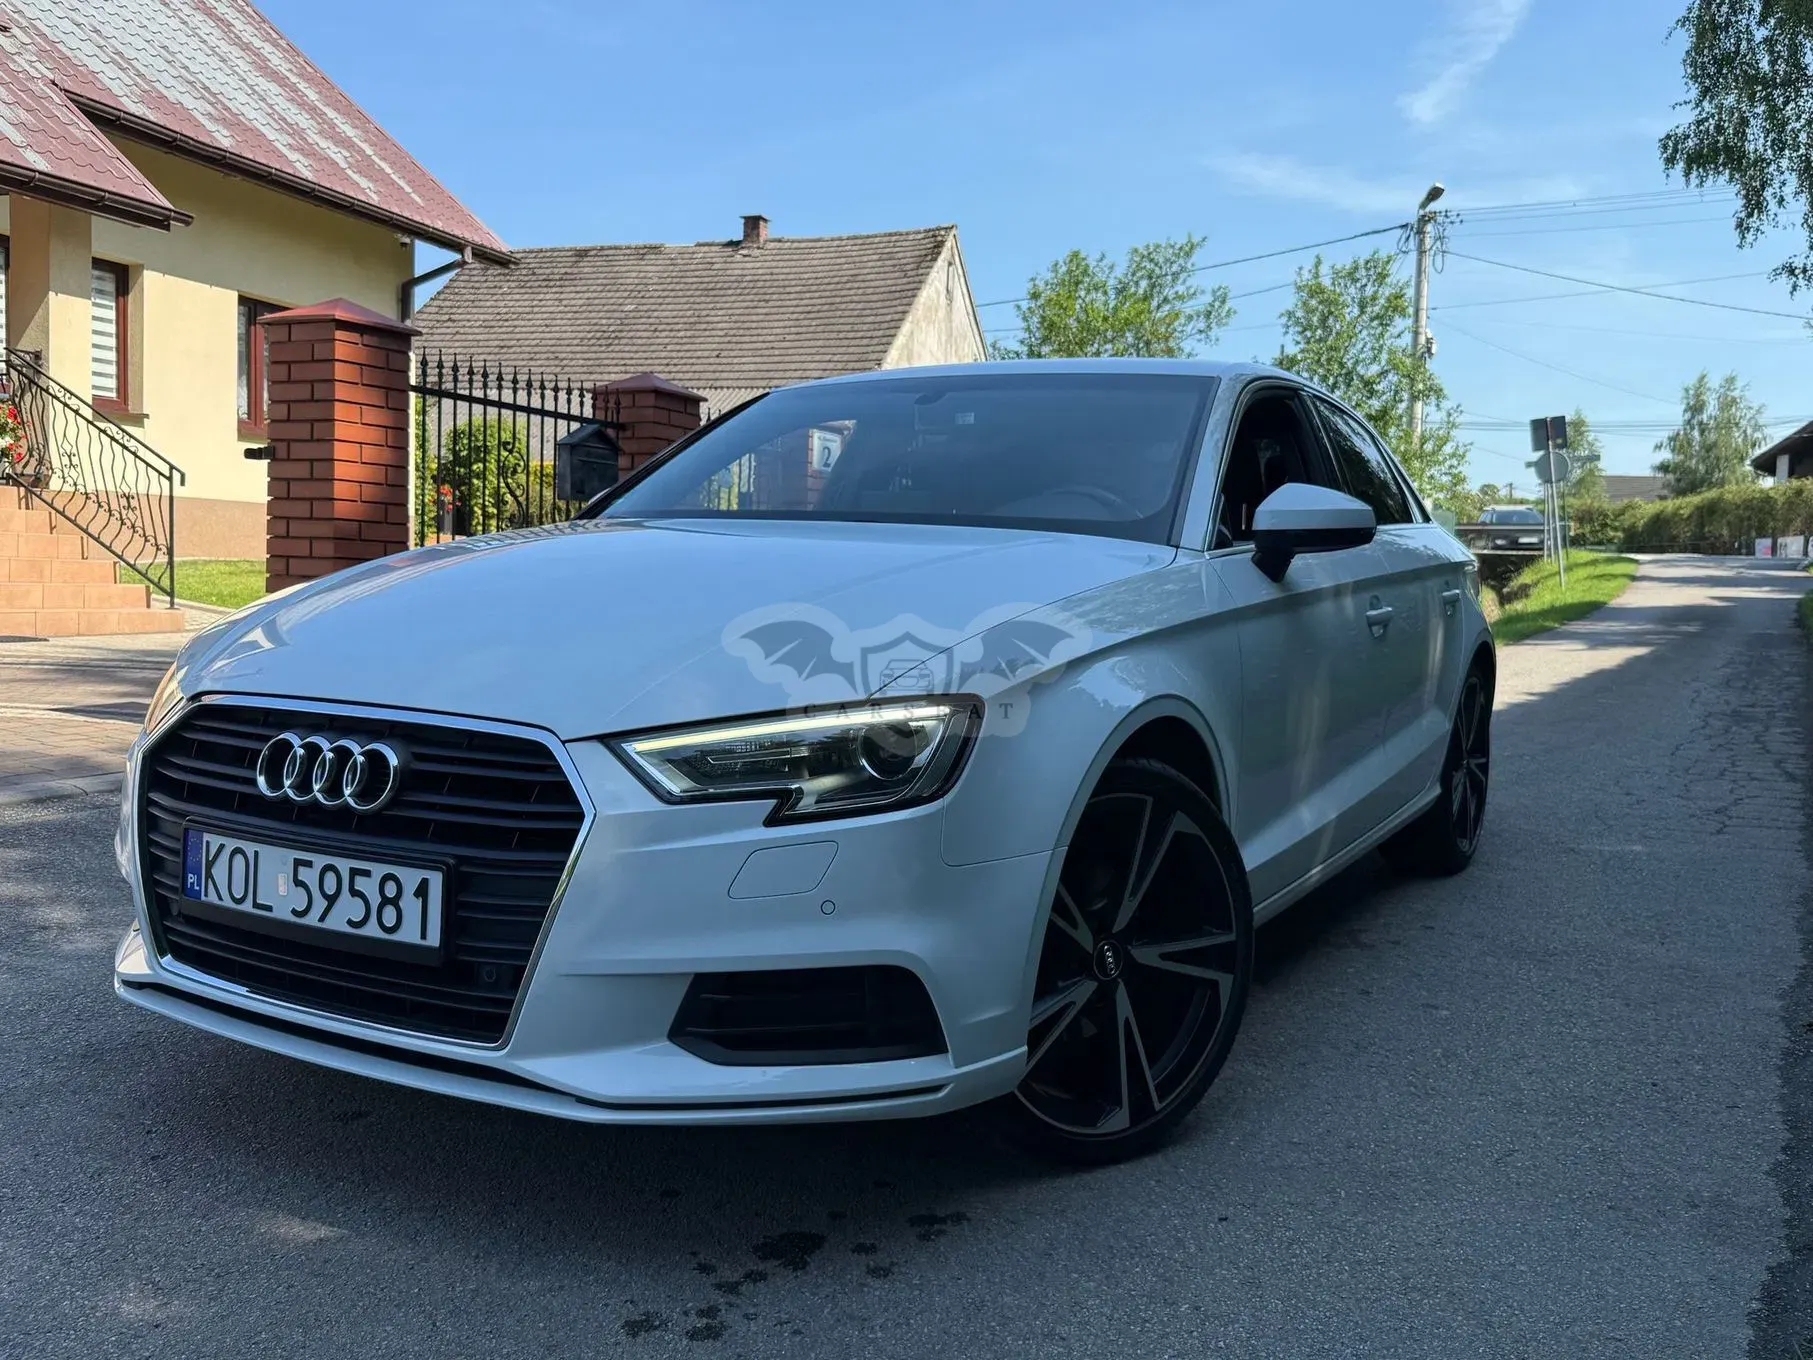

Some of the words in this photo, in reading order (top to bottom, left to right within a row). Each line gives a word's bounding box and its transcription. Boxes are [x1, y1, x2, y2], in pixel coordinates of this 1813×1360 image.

[822, 445, 831, 468] 2
[187, 873, 200, 891] PL
[203, 839, 274, 913] KOL
[290, 857, 430, 941] 59581
